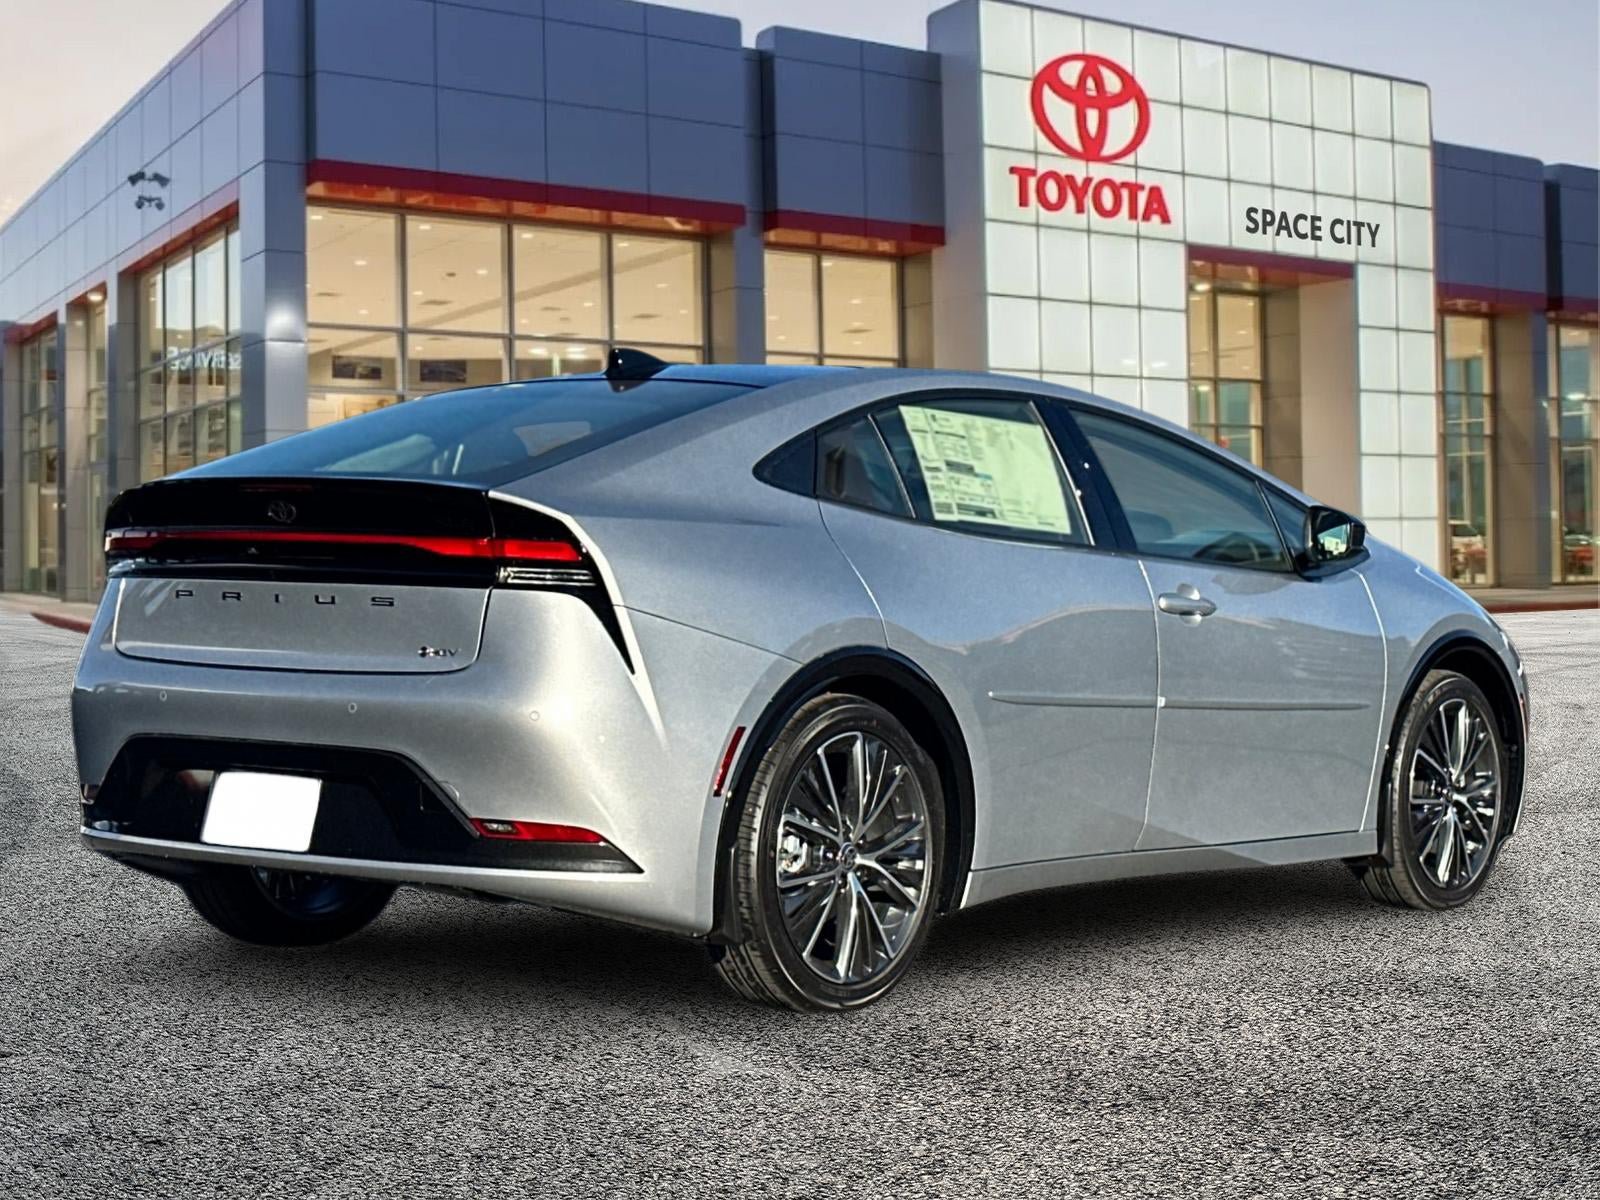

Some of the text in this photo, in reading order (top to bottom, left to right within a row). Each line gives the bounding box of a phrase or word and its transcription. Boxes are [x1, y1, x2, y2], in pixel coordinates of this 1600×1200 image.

[1009, 166, 1171, 224] TOYOTA
[1245, 207, 1381, 248] SPACE CITY
[175, 589, 395, 607] PRIUS
